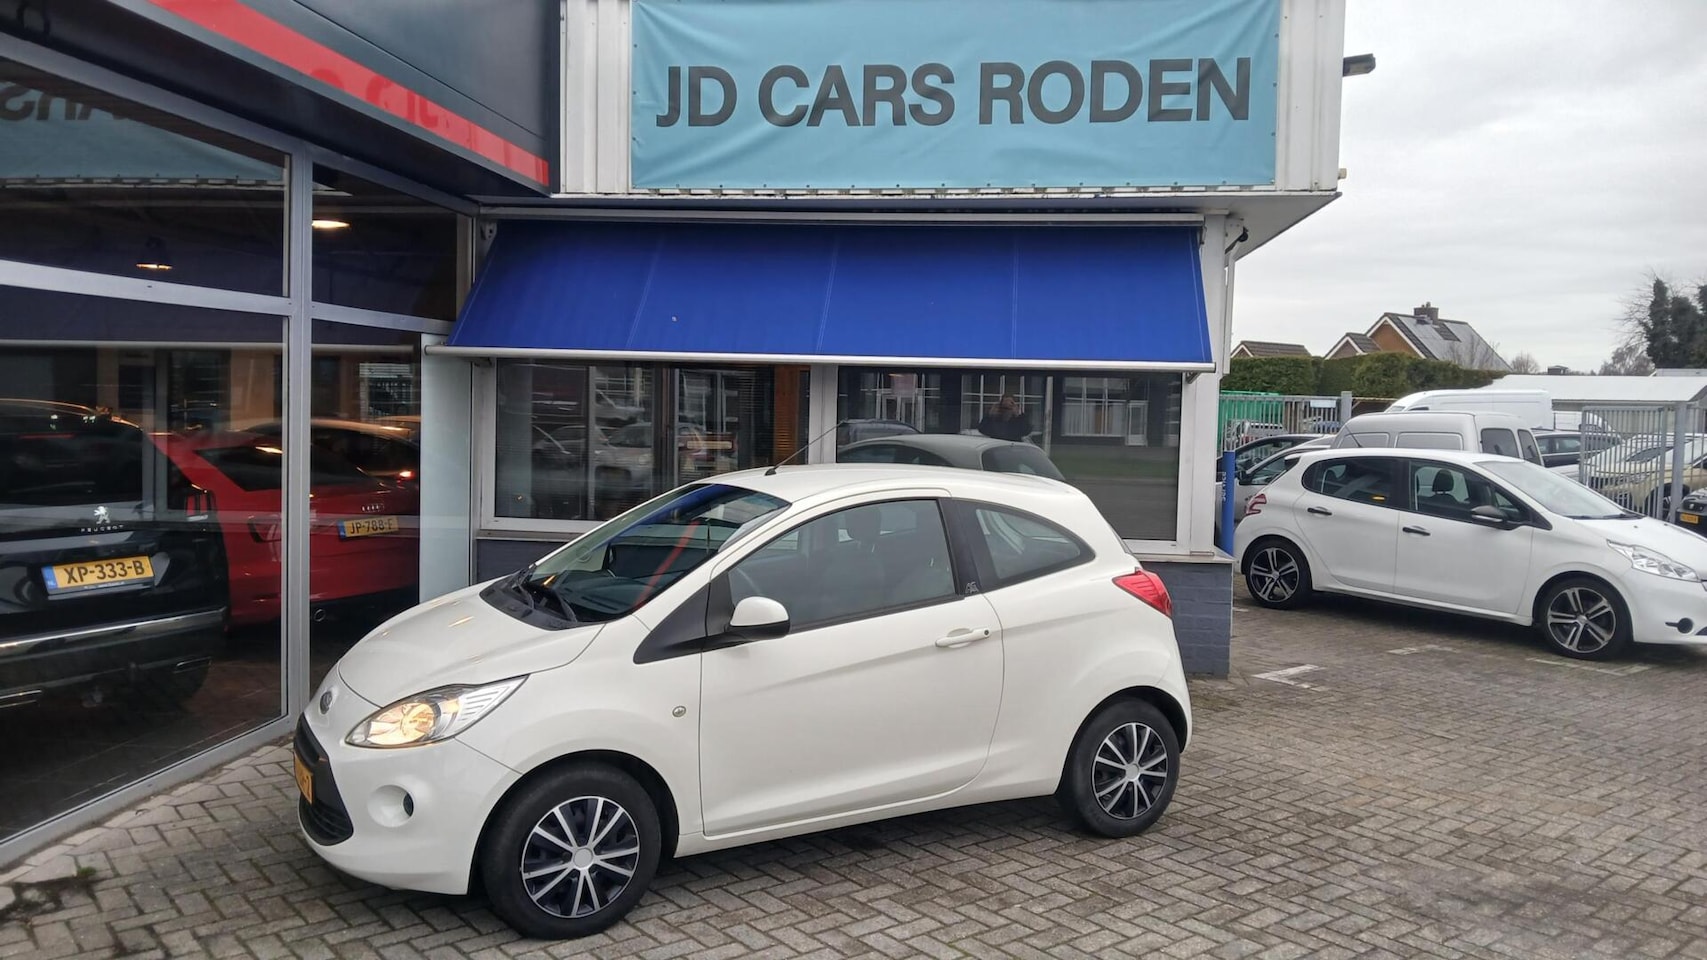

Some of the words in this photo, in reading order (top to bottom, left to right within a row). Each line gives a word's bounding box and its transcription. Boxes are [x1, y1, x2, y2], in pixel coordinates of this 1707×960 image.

[656, 66, 738, 127] JD
[758, 63, 955, 127] CARS
[979, 57, 1251, 125] RODEN
[64, 560, 145, 584] XP-333-B
